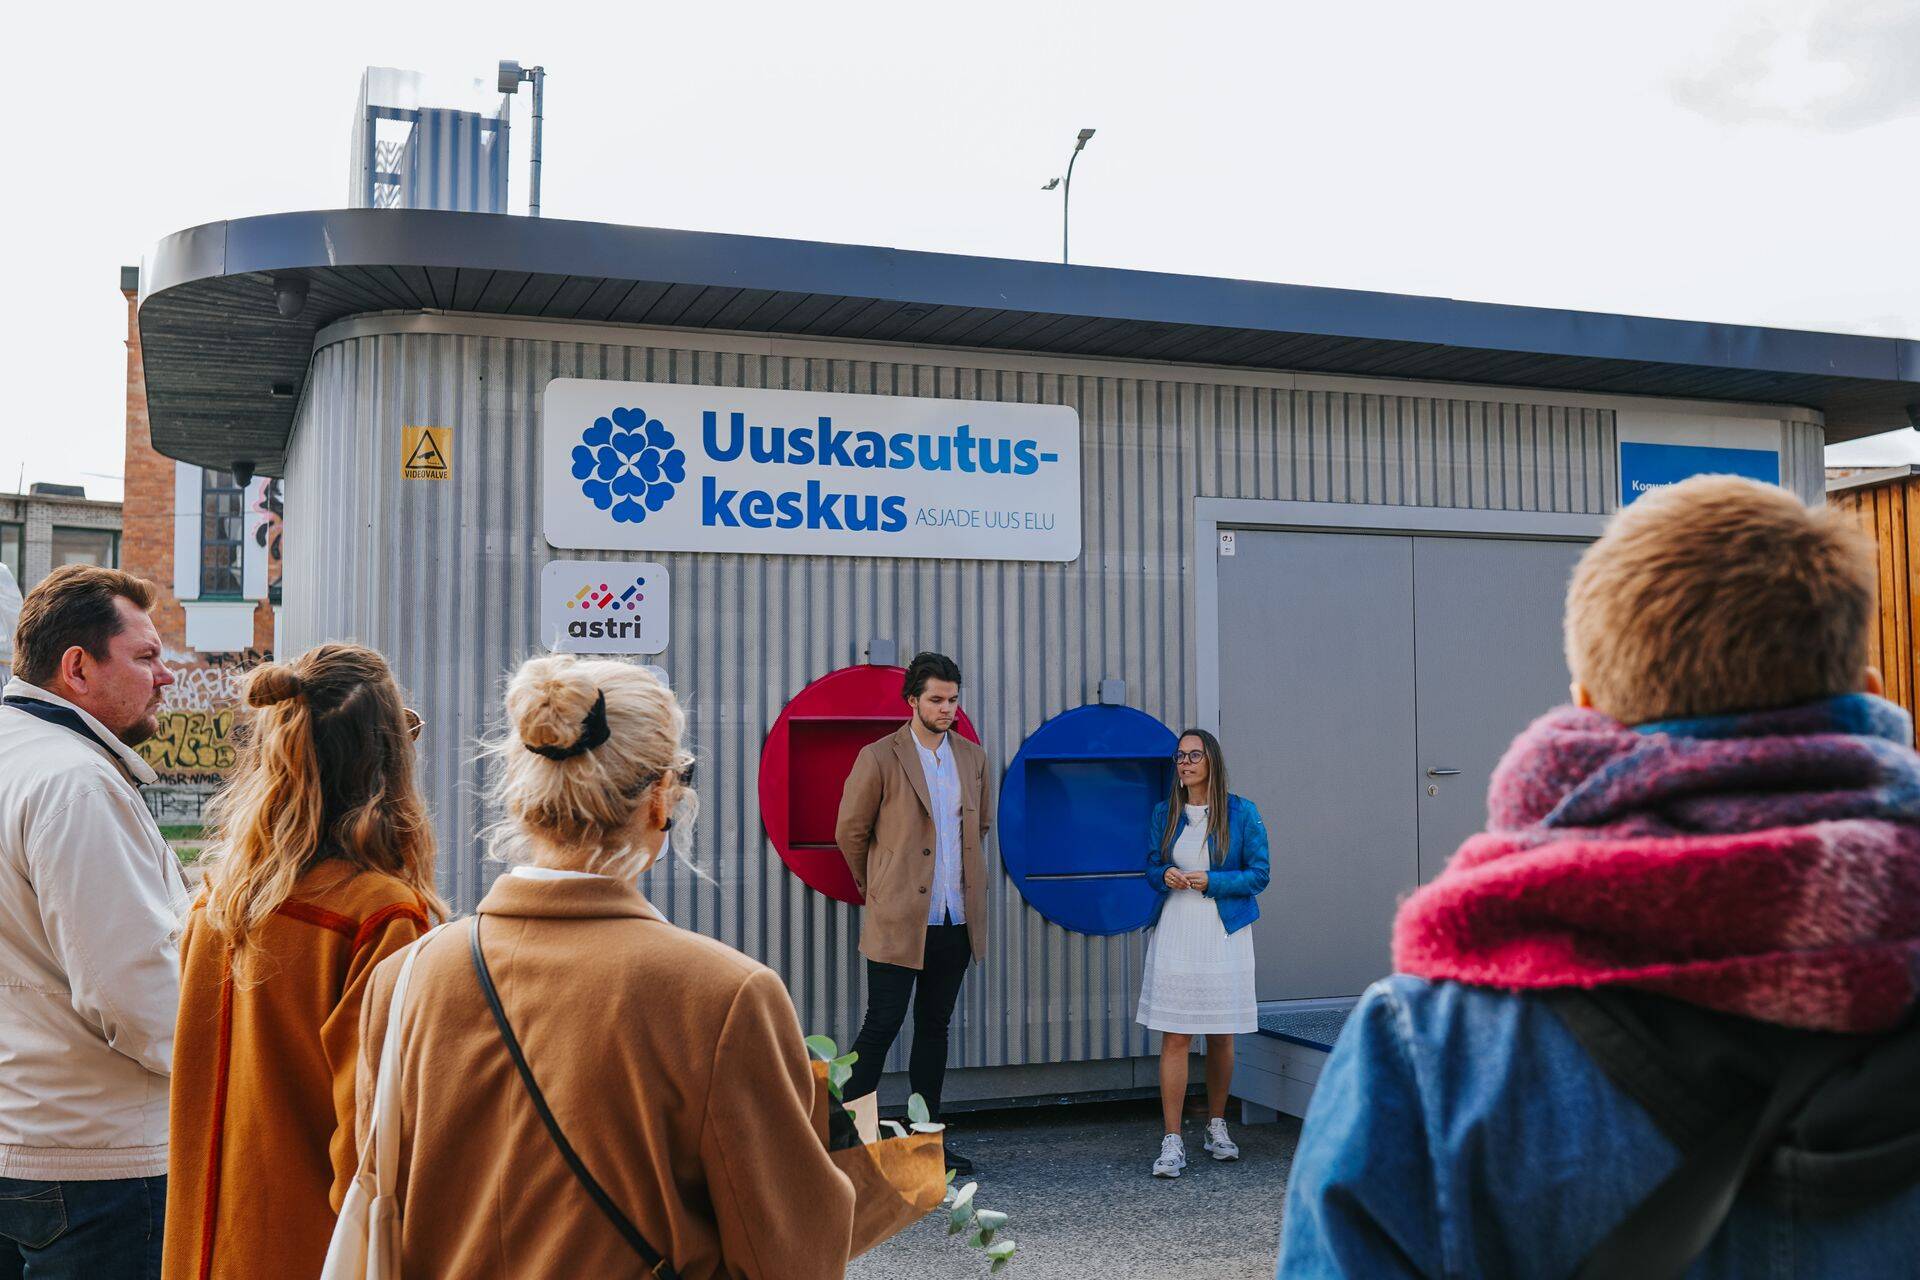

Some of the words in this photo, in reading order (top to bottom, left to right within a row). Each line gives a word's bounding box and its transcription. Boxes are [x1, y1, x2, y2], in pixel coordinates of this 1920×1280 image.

[703, 411, 1058, 475] Uuskasutus-
[405, 470, 448, 479] VIDEOVALVE
[702, 476, 908, 532] keskus
[915, 508, 980, 528] ASJADE
[985, 511, 1020, 529] UUS
[1025, 512, 1055, 531] ELU
[568, 615, 641, 639] astri
